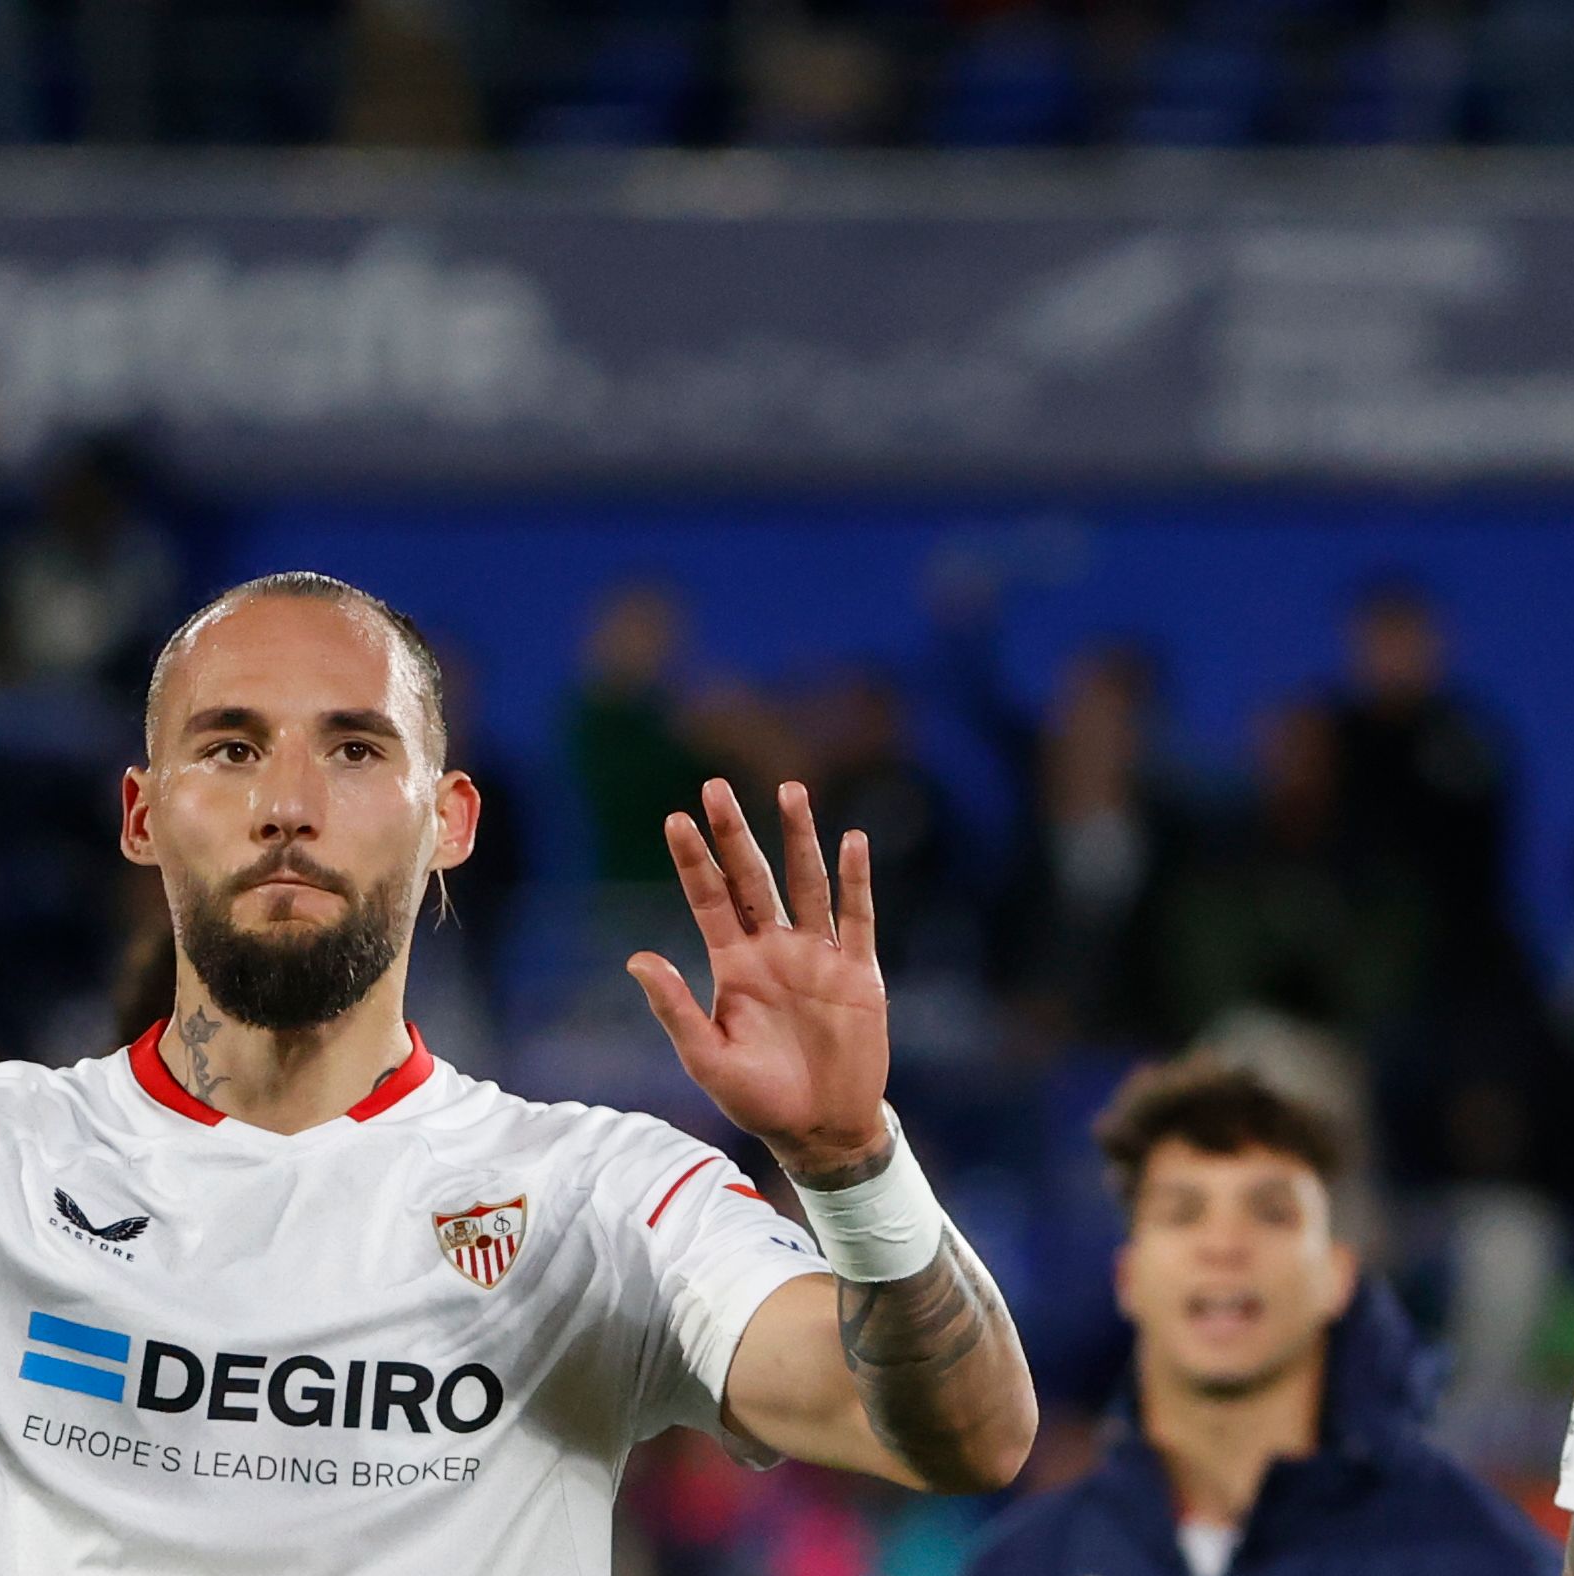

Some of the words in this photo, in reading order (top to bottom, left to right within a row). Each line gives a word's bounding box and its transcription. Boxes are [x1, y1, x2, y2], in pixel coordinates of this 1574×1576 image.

[49, 1217, 135, 1262] CASTORE
[137, 1339, 504, 1434] DEGIRO
[193, 1450, 339, 1486] LEADING
[352, 1456, 481, 1488] BROKER
